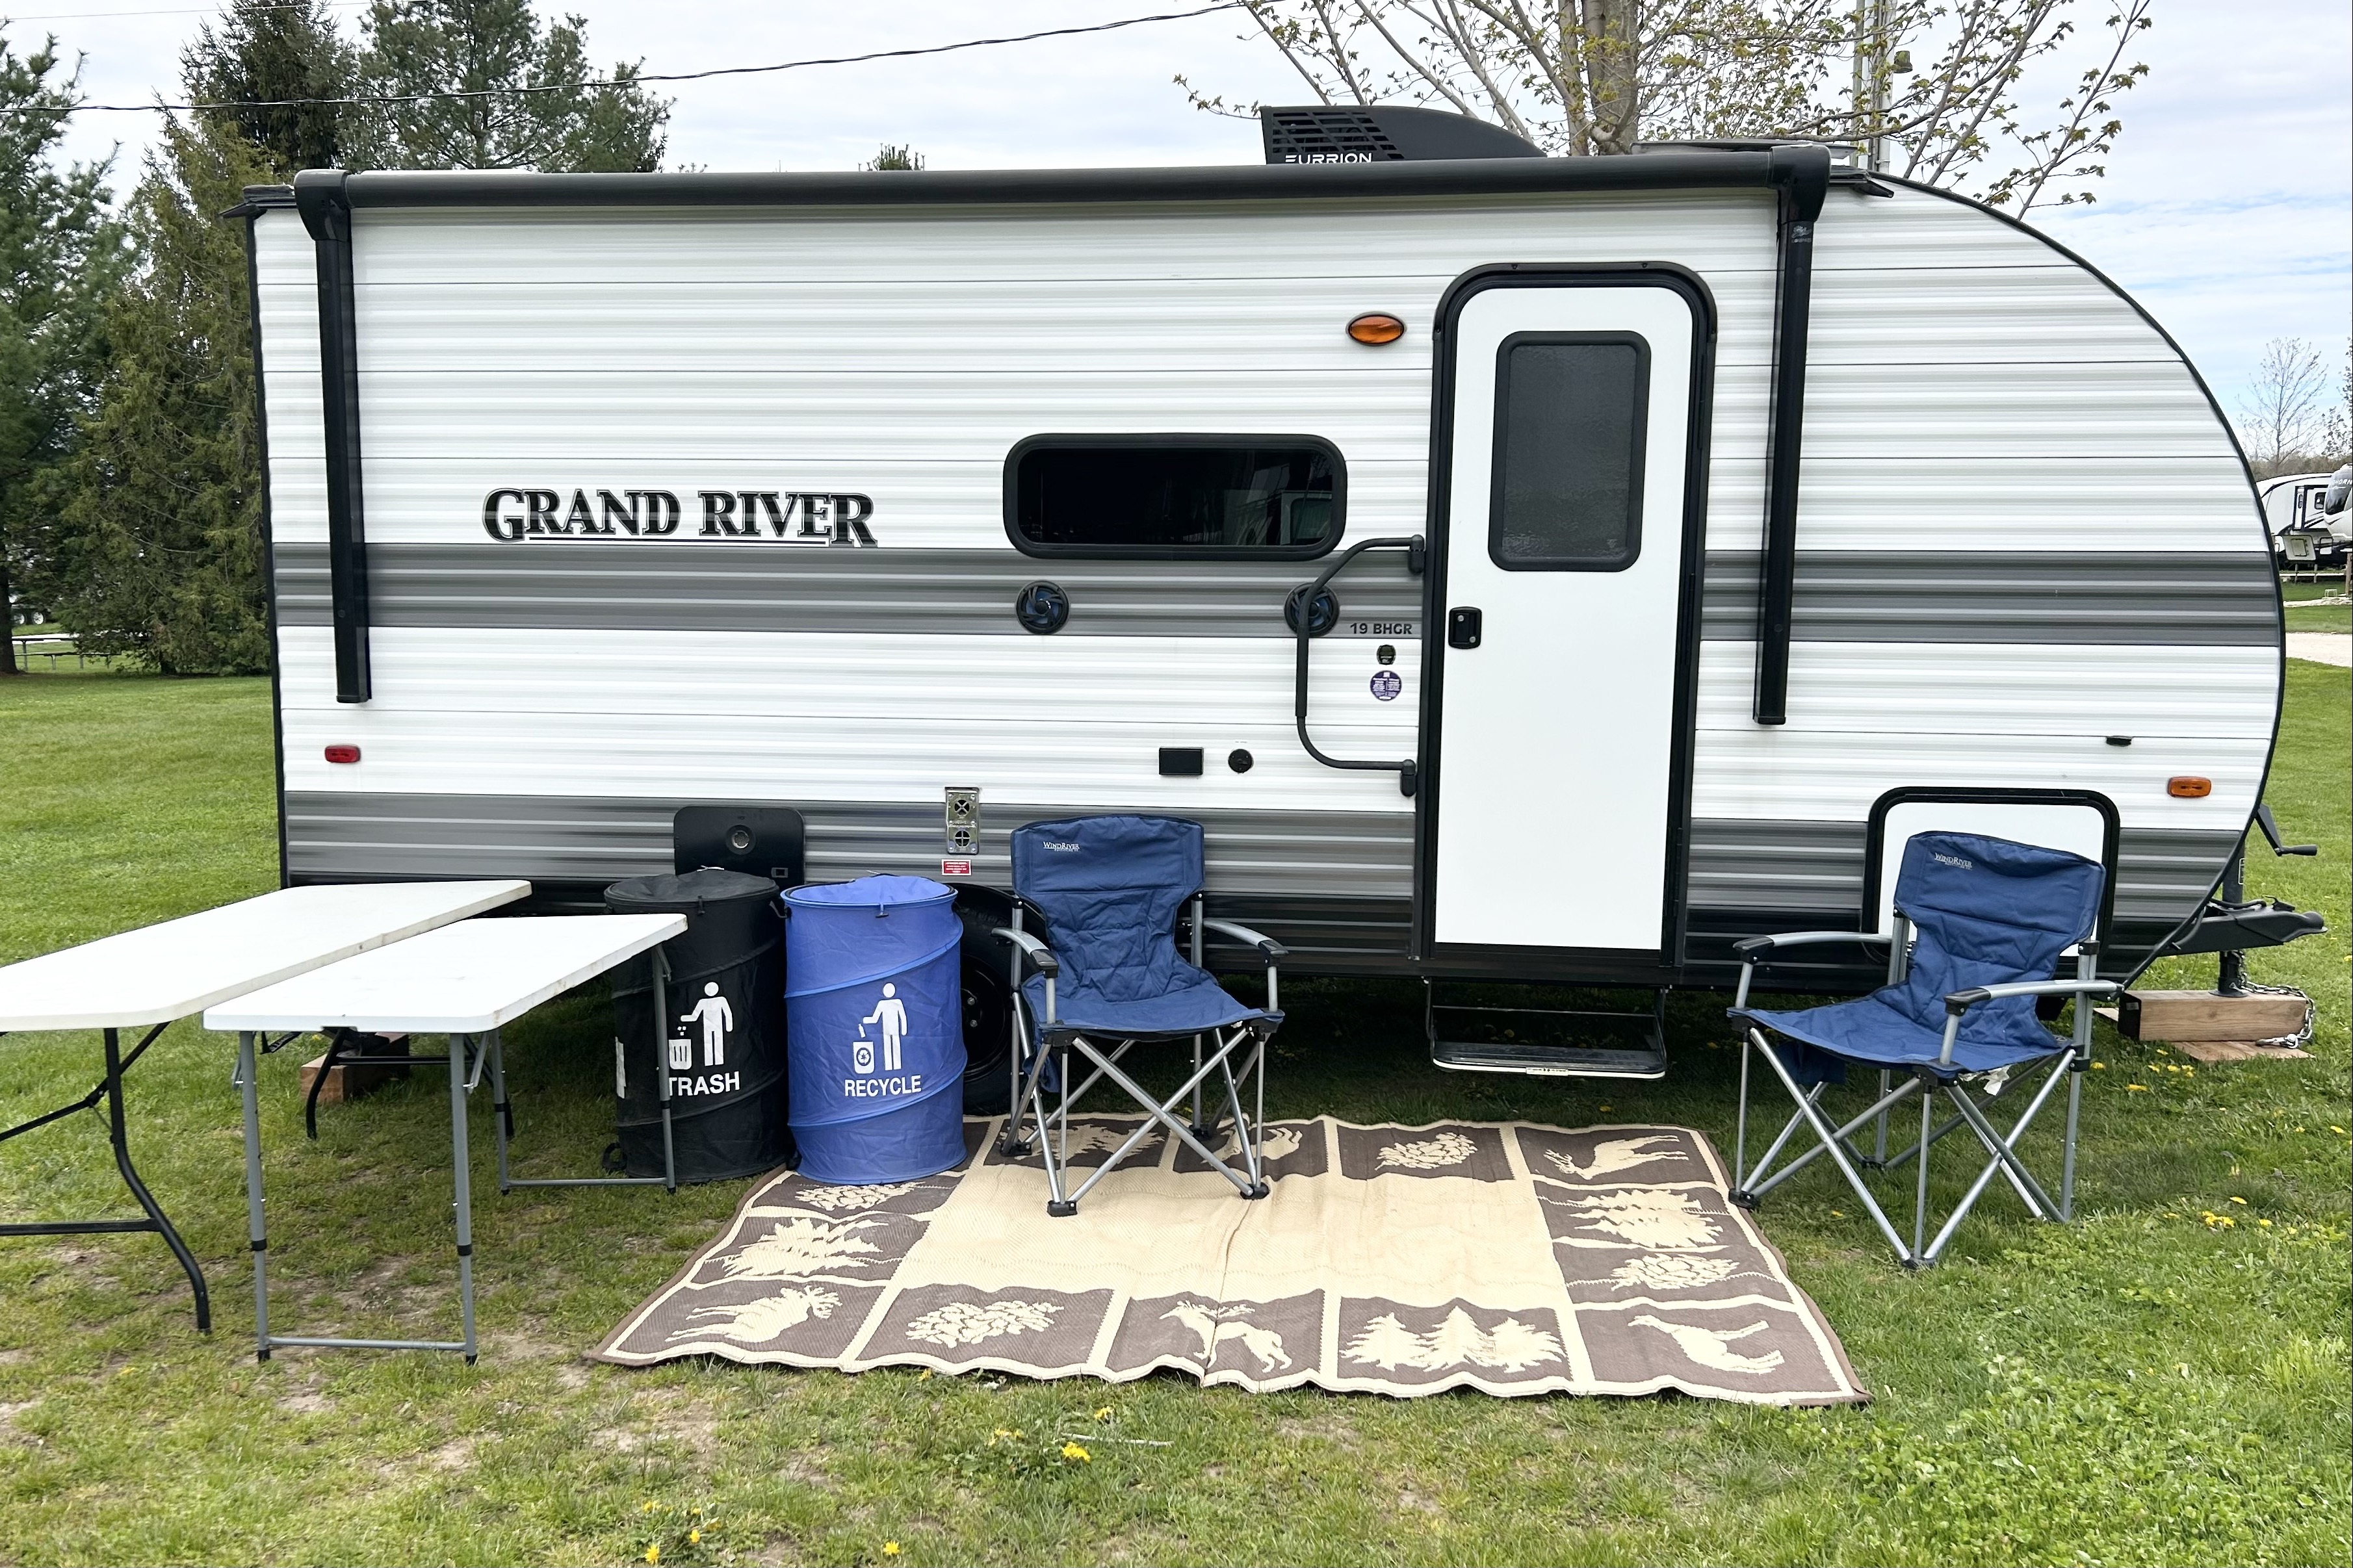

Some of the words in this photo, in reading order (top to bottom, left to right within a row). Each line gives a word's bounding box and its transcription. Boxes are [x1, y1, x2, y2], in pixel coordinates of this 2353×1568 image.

[482, 487, 681, 543] GRAND
[698, 491, 878, 547] RIVER
[1350, 623, 1368, 634] 19
[1373, 623, 1412, 635] BHGR
[668, 1071, 740, 1096] TRASH
[844, 1074, 922, 1098] RECYCLE
